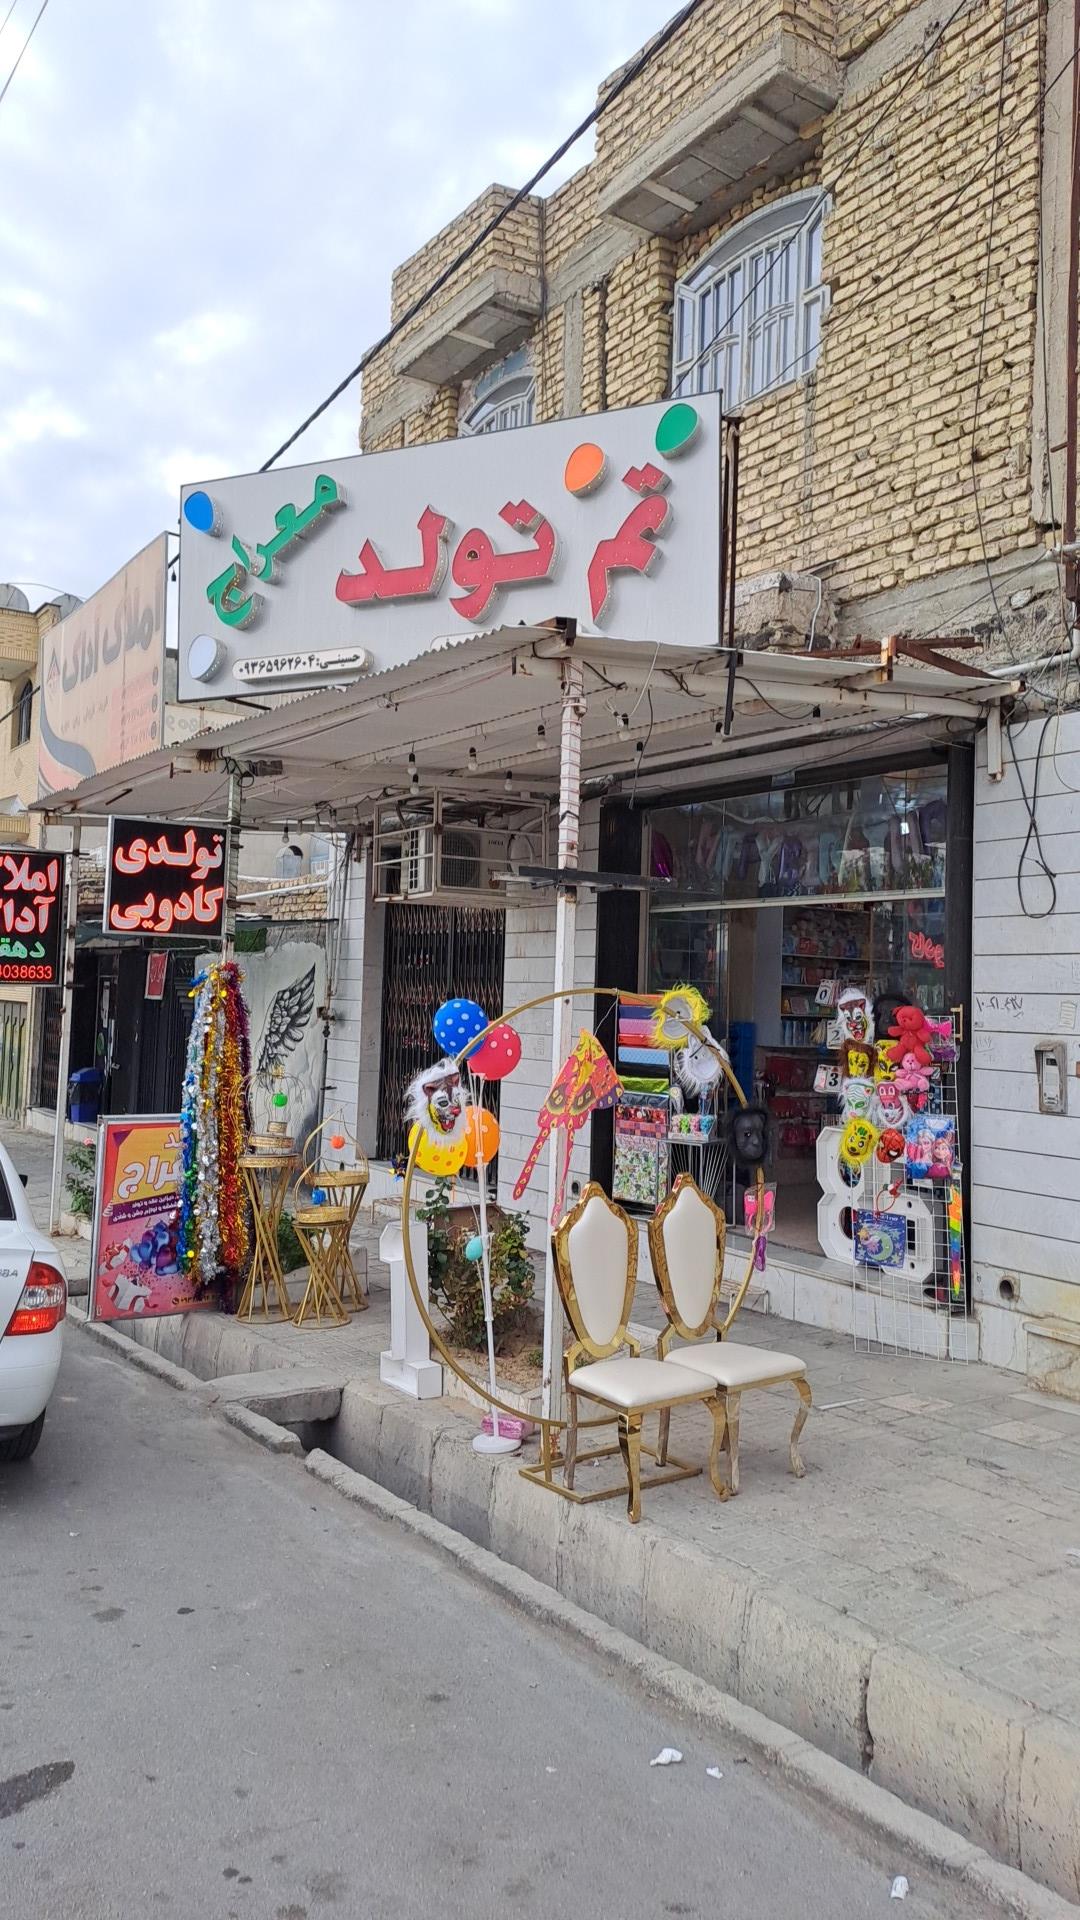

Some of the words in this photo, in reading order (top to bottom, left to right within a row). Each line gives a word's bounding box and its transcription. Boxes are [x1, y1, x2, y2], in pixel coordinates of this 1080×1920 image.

[207, 474, 344, 628] معراج
[336, 499, 556, 620] تولد
[588, 462, 671, 622] تم
[0, 855, 58, 892] املا
[115, 830, 224, 879] تولدی
[0, 895, 56, 934] آدا
[111, 885, 224, 931] کادویی
[0, 937, 46, 959] دهق
[0, 964, 53, 979] 038633
